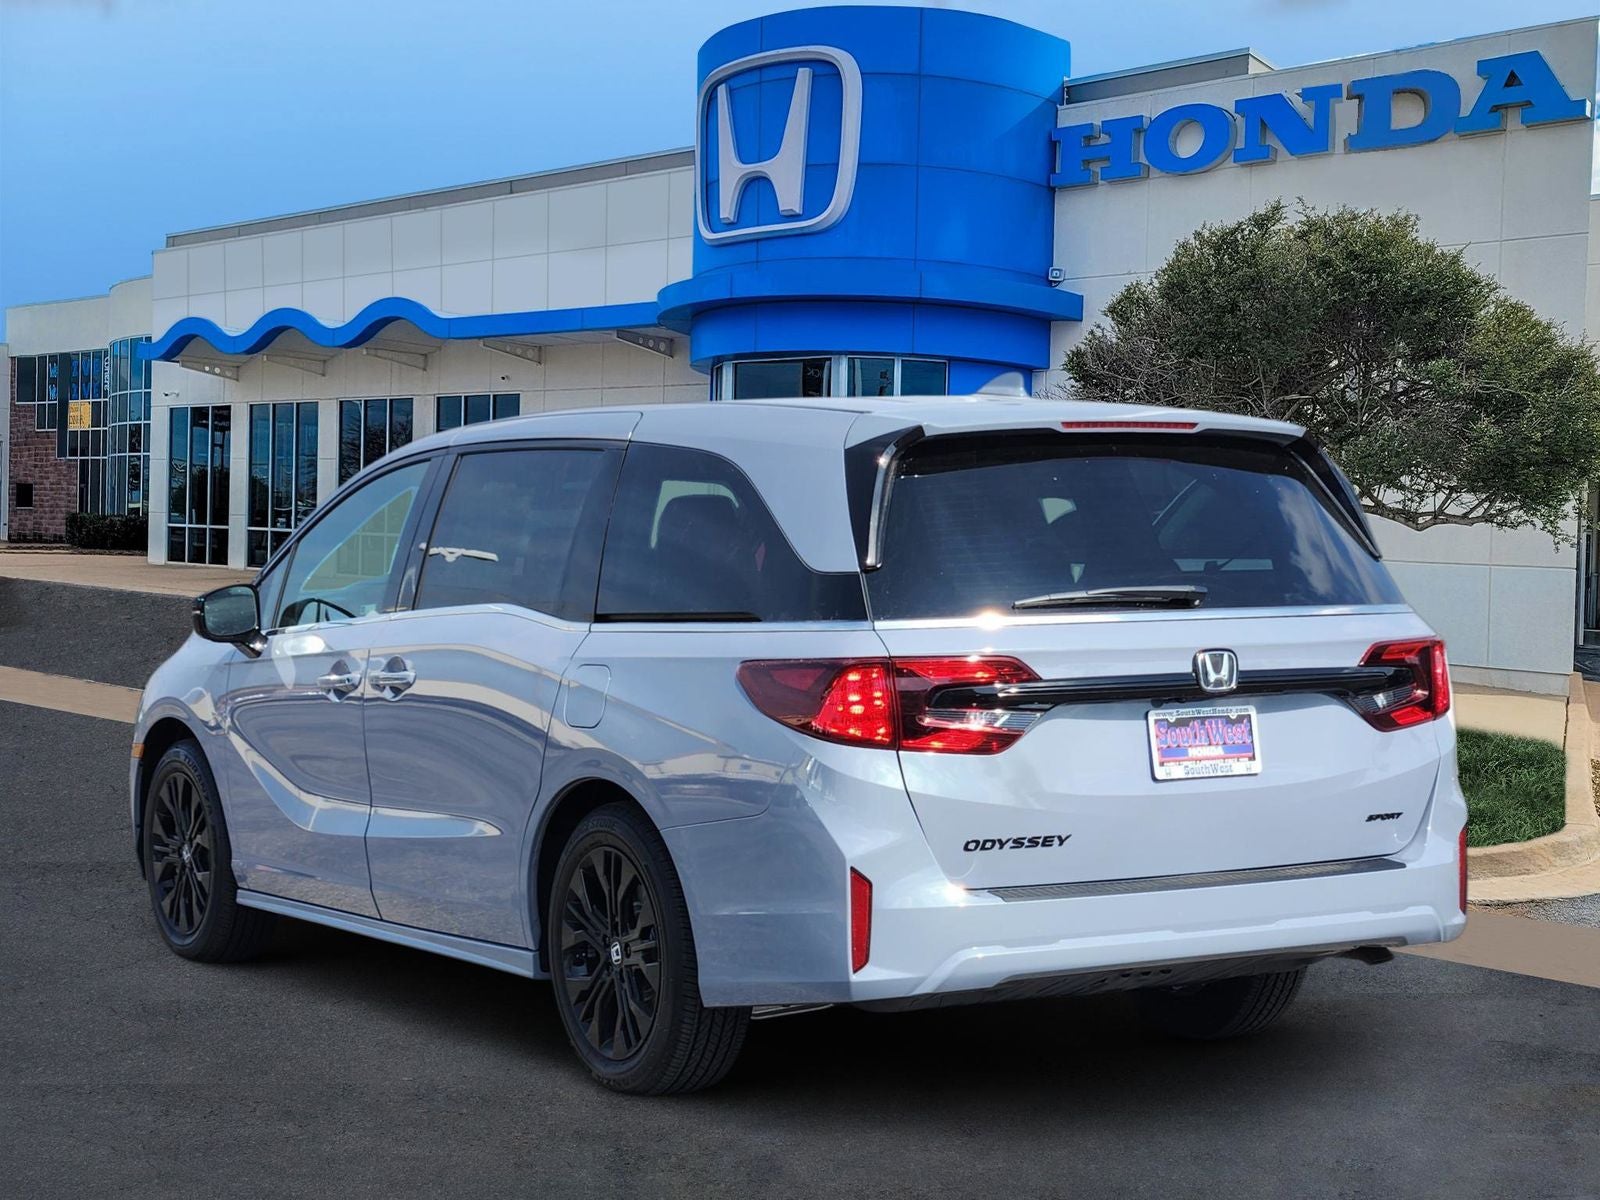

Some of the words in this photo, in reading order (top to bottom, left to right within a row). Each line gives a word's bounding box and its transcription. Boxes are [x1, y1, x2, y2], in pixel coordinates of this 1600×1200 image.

[1050, 50, 1591, 188] HONDA
[1156, 719, 1252, 748] SouthWest
[1184, 763, 1234, 776] SouthWest
[1365, 811, 1404, 822] SPORT
[963, 834, 1072, 852] ODYSSEY
